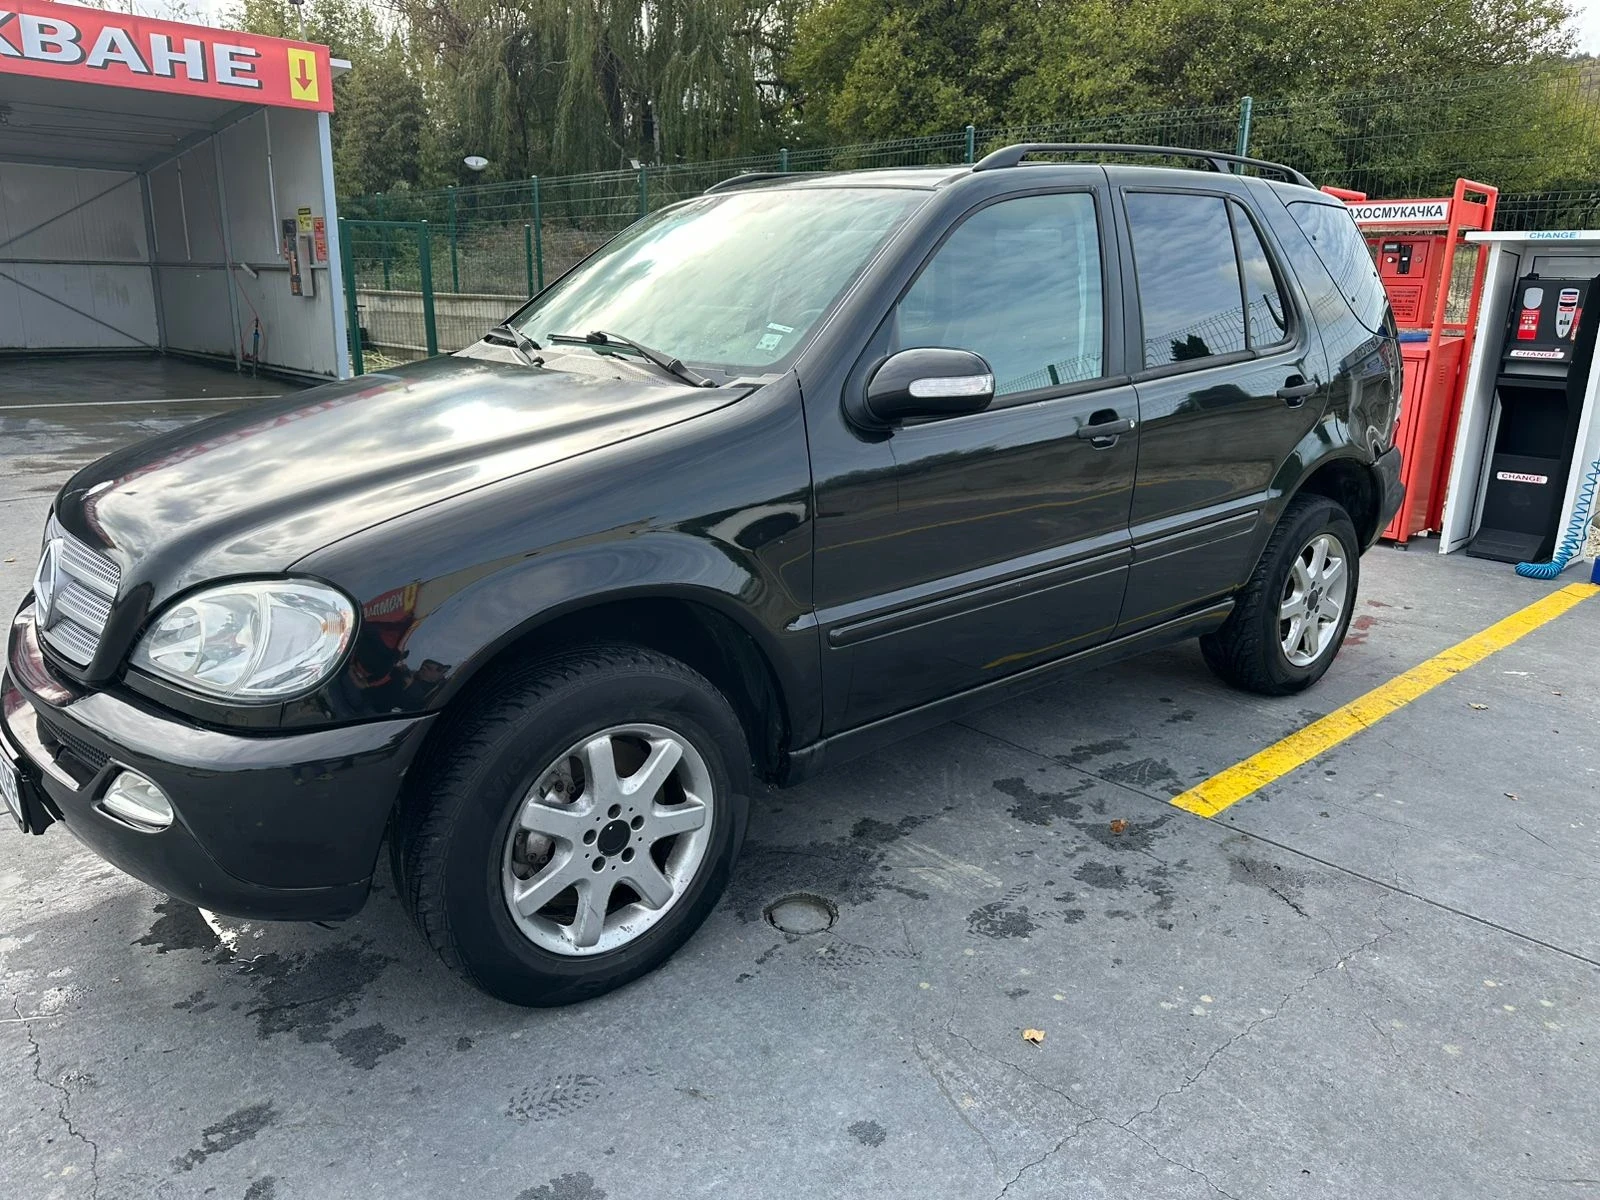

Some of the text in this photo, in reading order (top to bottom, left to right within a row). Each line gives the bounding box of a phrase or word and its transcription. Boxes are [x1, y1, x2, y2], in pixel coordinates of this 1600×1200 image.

[1529, 231, 1577, 239] CHANGE
[1515, 350, 1559, 358] CHANGE
[1501, 473, 1543, 482] CHANGE
